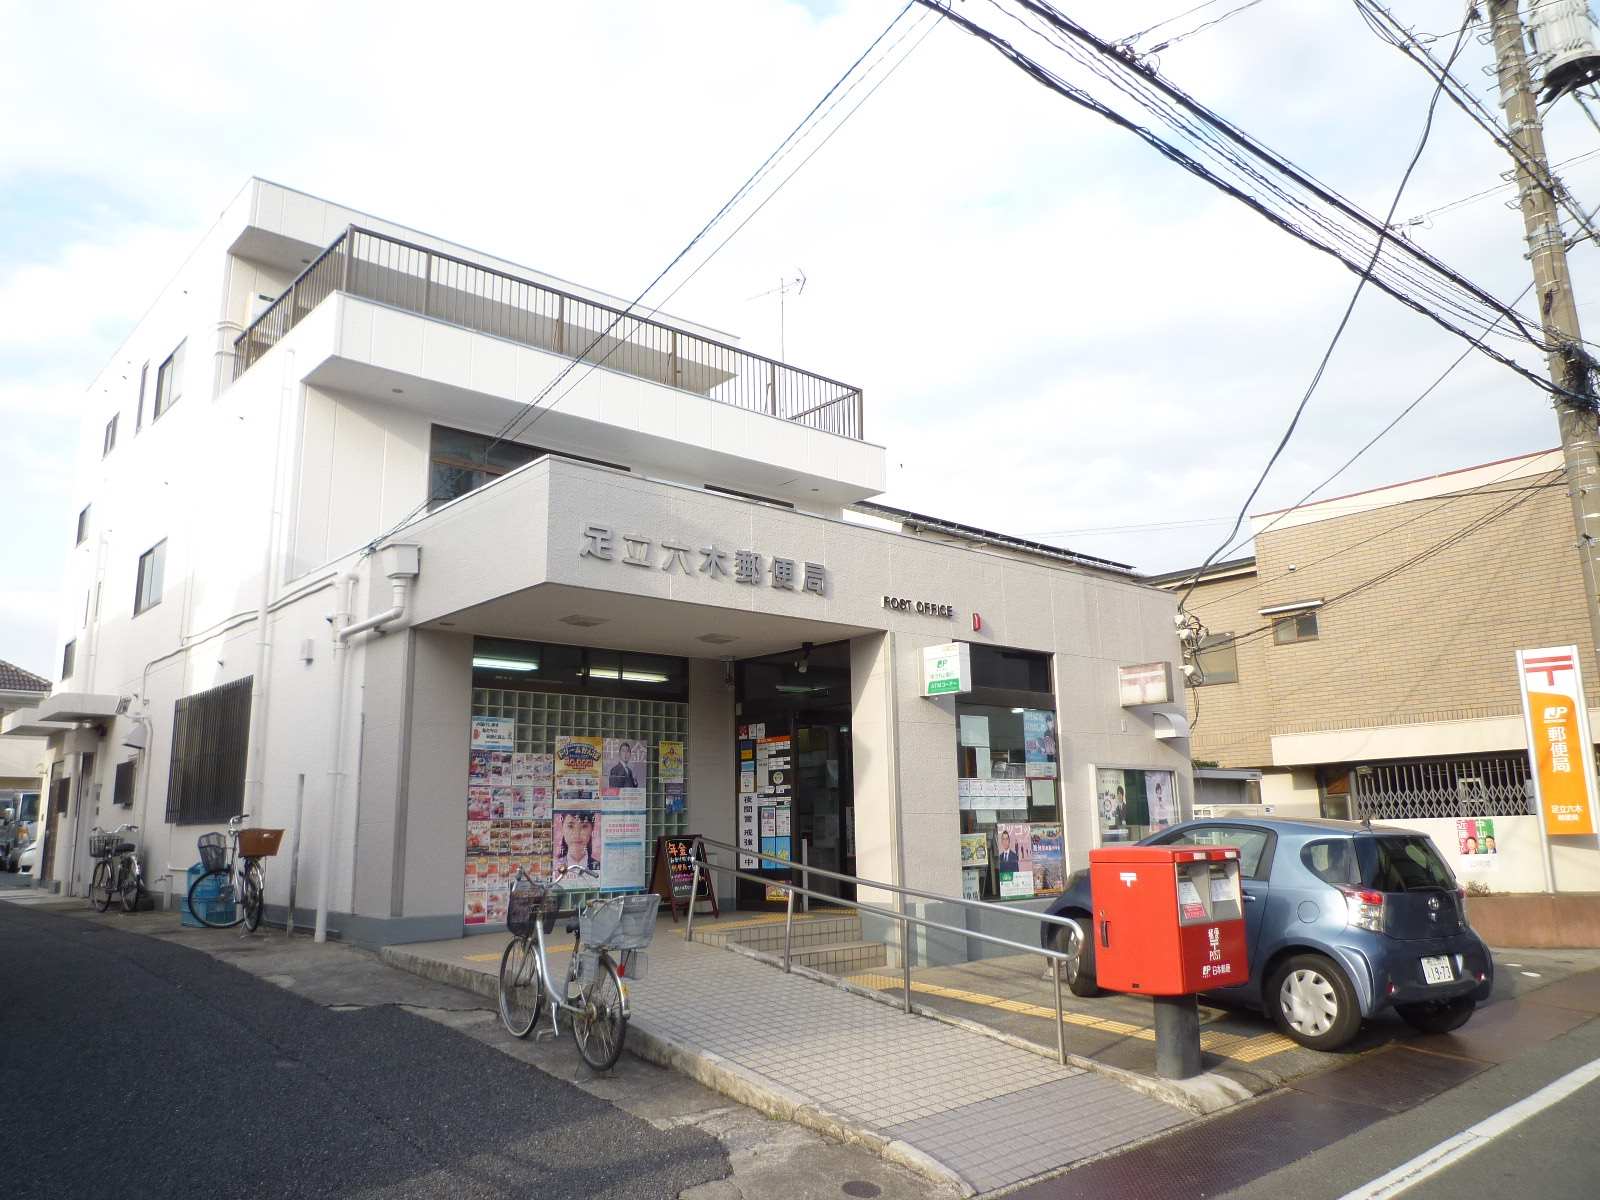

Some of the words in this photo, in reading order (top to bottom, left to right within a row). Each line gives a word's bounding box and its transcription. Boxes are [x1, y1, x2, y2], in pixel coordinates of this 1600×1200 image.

[580, 525, 826, 597] 足立六木郵便局
[883, 595, 912, 612] POST
[916, 600, 953, 617] OFFICE
[1548, 726, 1571, 773] 郵便局
[1209, 949, 1221, 961] POST
